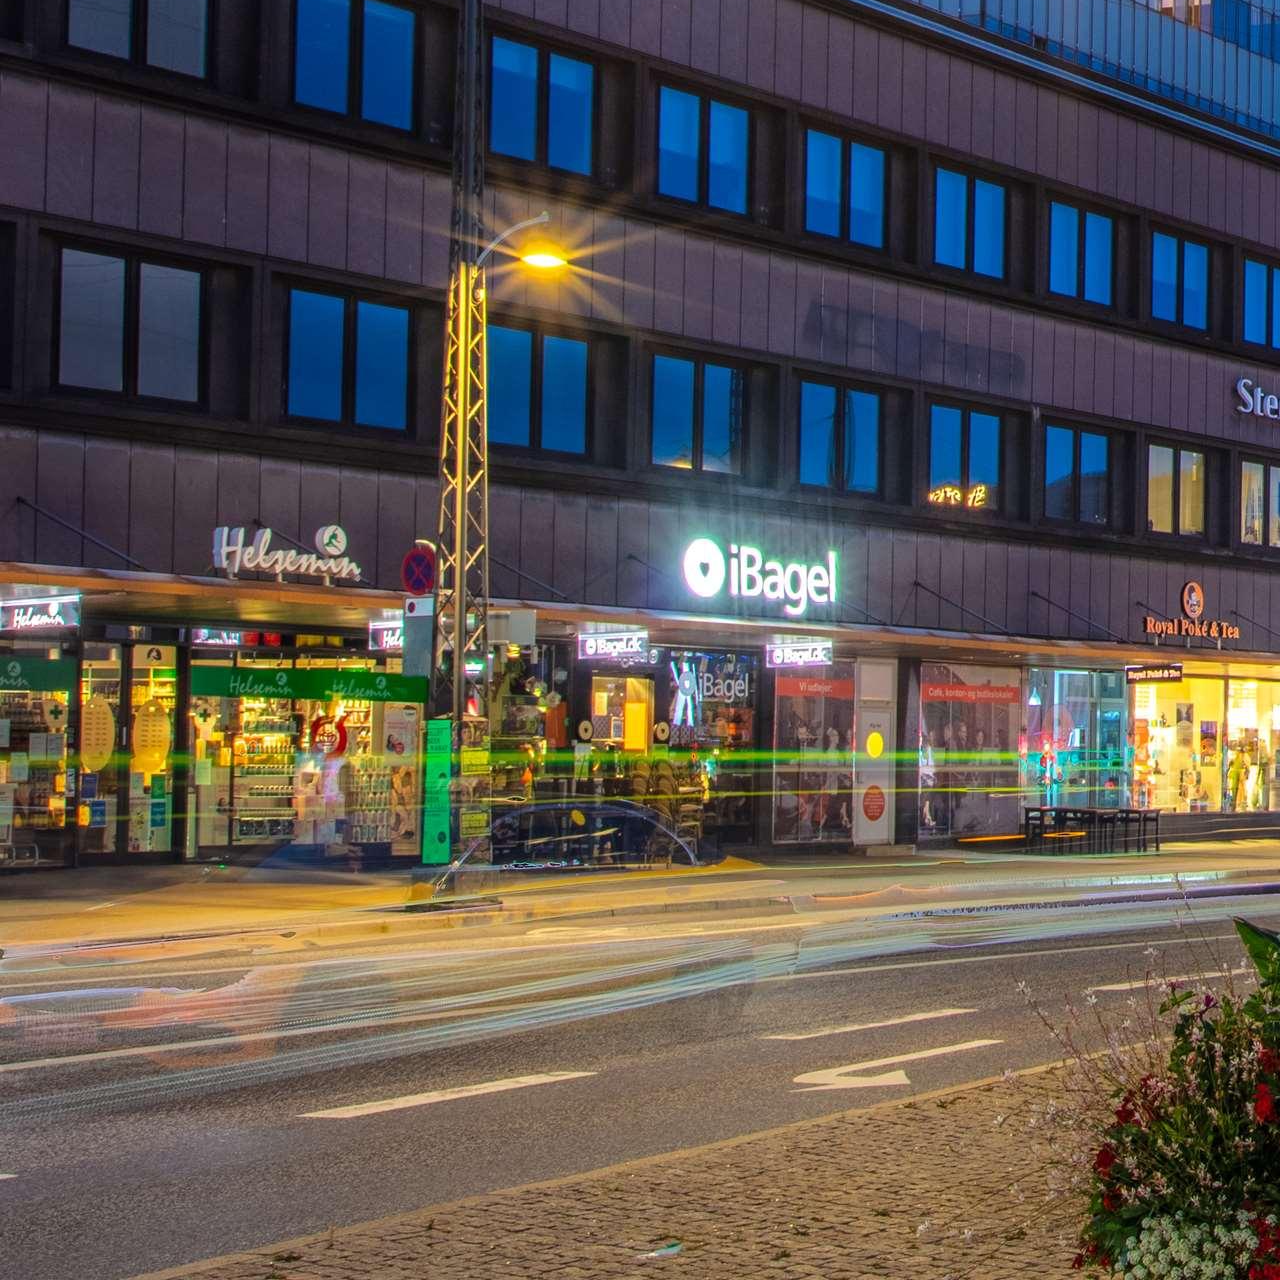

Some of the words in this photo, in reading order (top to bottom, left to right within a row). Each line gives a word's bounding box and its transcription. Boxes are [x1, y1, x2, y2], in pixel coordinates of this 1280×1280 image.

[213, 526, 361, 582] Helsemin
[730, 544, 837, 615] iBagel
[13, 609, 64, 630] Helsemin
[1146, 616, 1178, 638] Royal
[1181, 616, 1207, 638] Poké
[1210, 621, 1219, 637] &
[1220, 622, 1240, 640] Tea
[700, 672, 749, 703] iBagel
